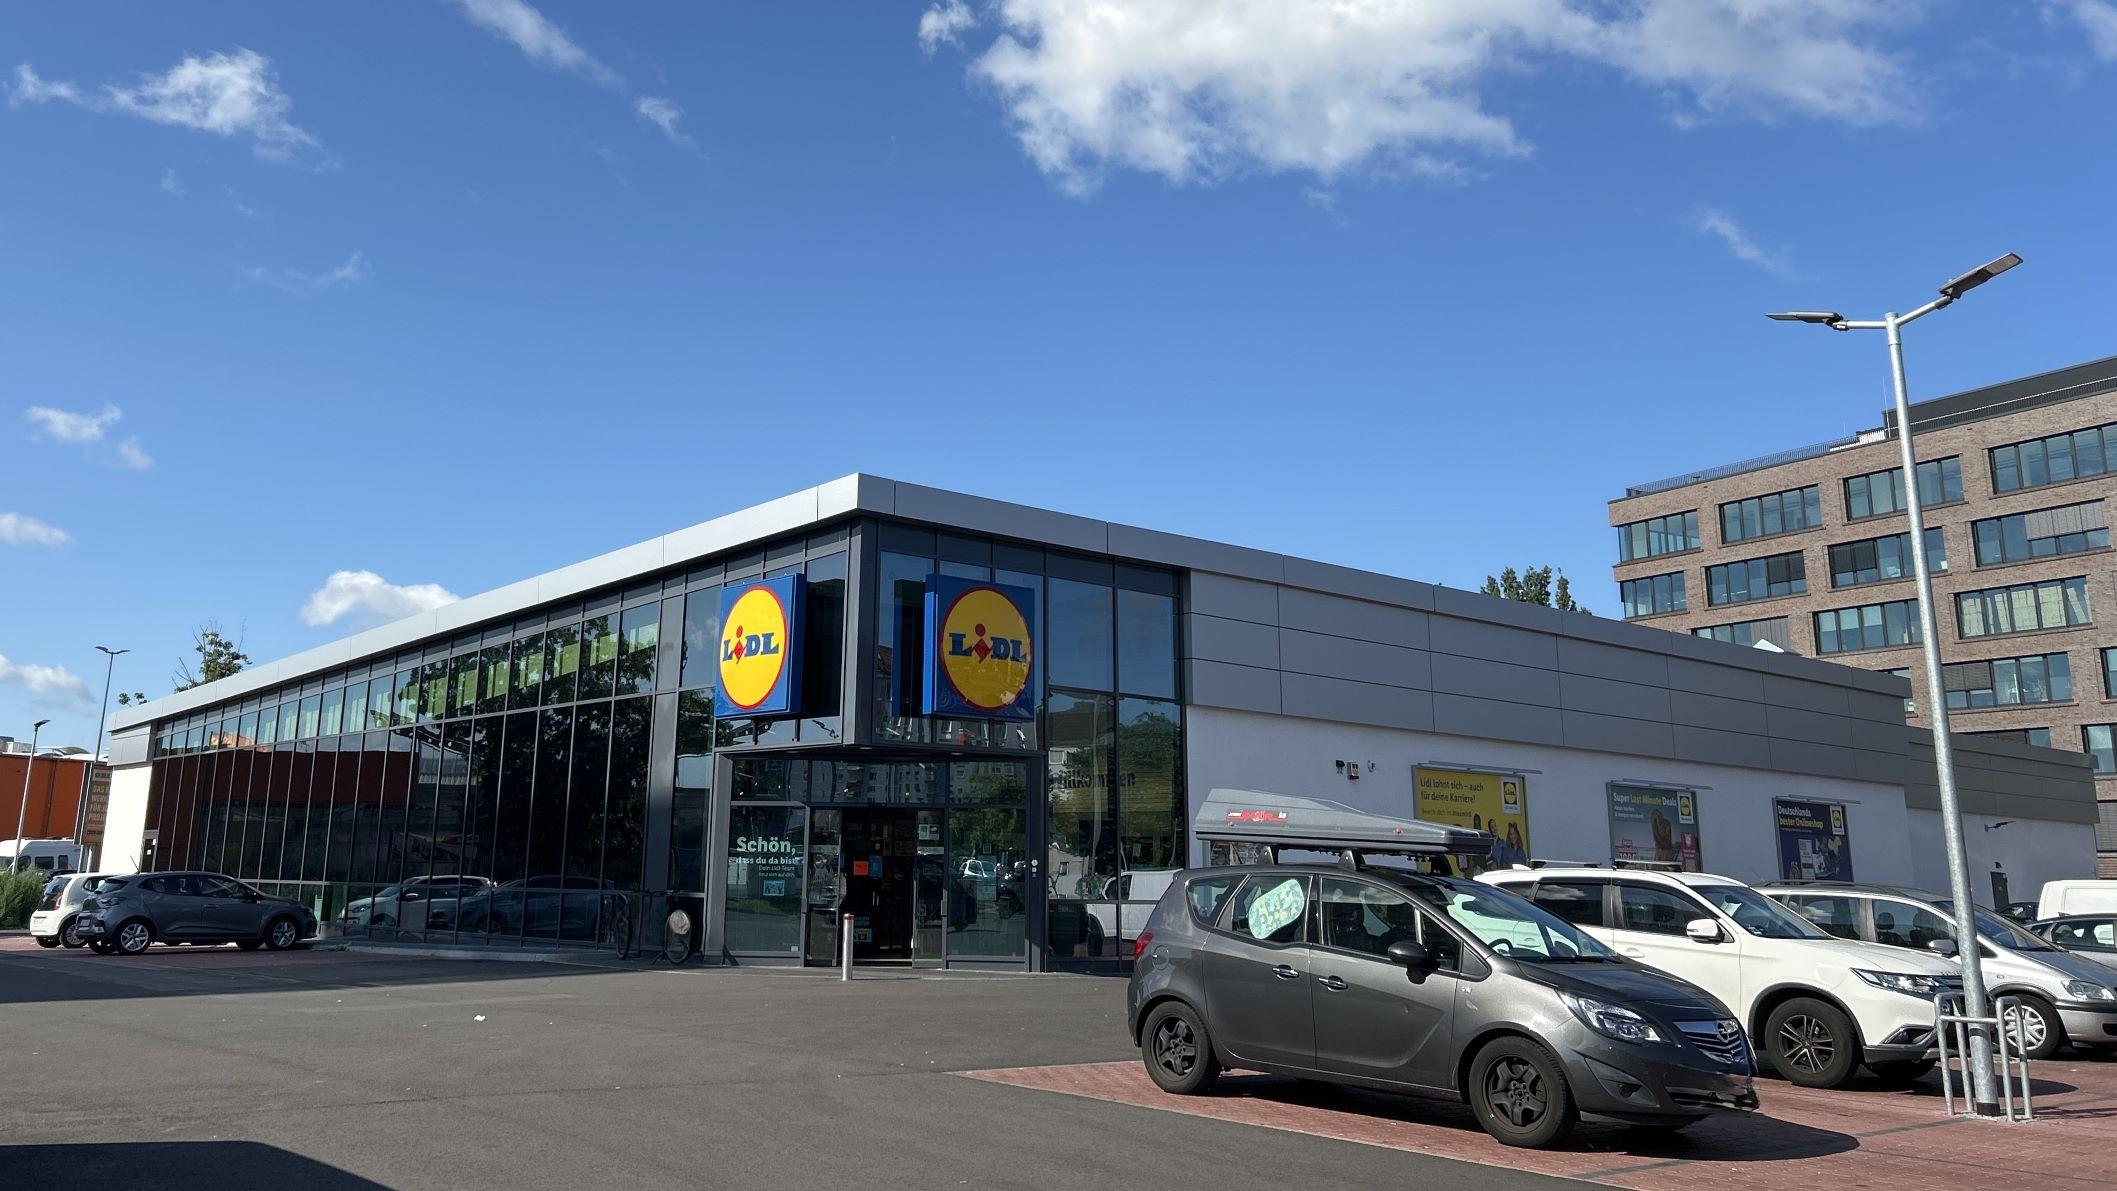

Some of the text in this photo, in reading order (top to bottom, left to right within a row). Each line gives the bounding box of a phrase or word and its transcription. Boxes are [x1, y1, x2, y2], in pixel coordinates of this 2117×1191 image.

[1420, 778, 1431, 787] Lidl
[1433, 779, 1449, 789] lohnt
[1450, 781, 1463, 790] sich
[1469, 783, 1484, 792] auch
[1431, 792, 1449, 801] deine
[1450, 793, 1475, 804] Karriere!
[1613, 793, 1629, 804] Super
[1630, 794, 1641, 805] Last
[1662, 796, 1677, 807] Deals
[1777, 805, 1811, 817] Deutschlands
[1779, 816, 1795, 826] bester
[1796, 818, 1823, 829] Onlineshop
[736, 836, 796, 855] Schön,
